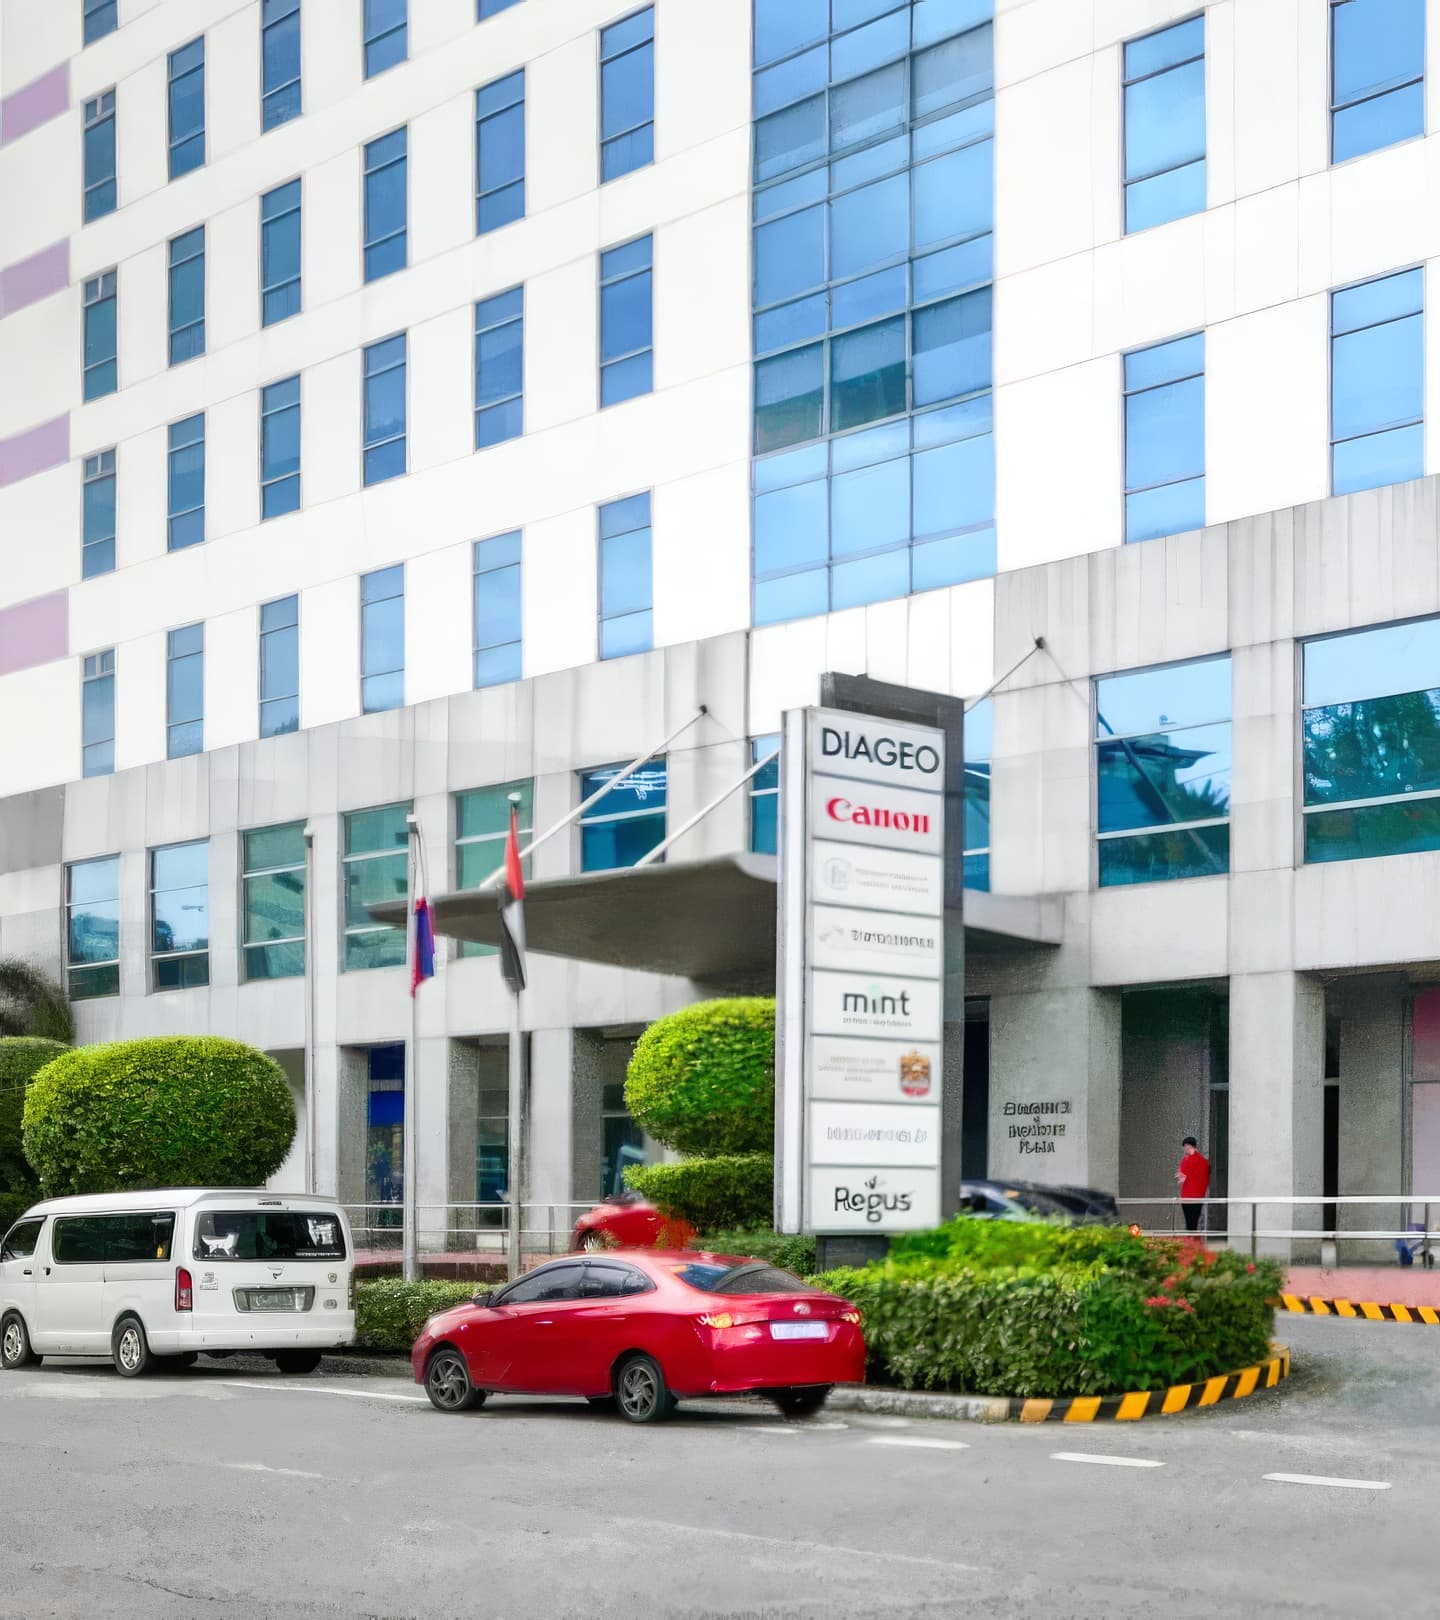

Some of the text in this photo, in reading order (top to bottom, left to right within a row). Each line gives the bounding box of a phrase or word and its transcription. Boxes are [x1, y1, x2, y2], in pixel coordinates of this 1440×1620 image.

[822, 728, 939, 773] DIAGEO
[827, 798, 930, 833] Canon
[843, 990, 911, 1016] mint
[834, 1187, 912, 1222] Regus
